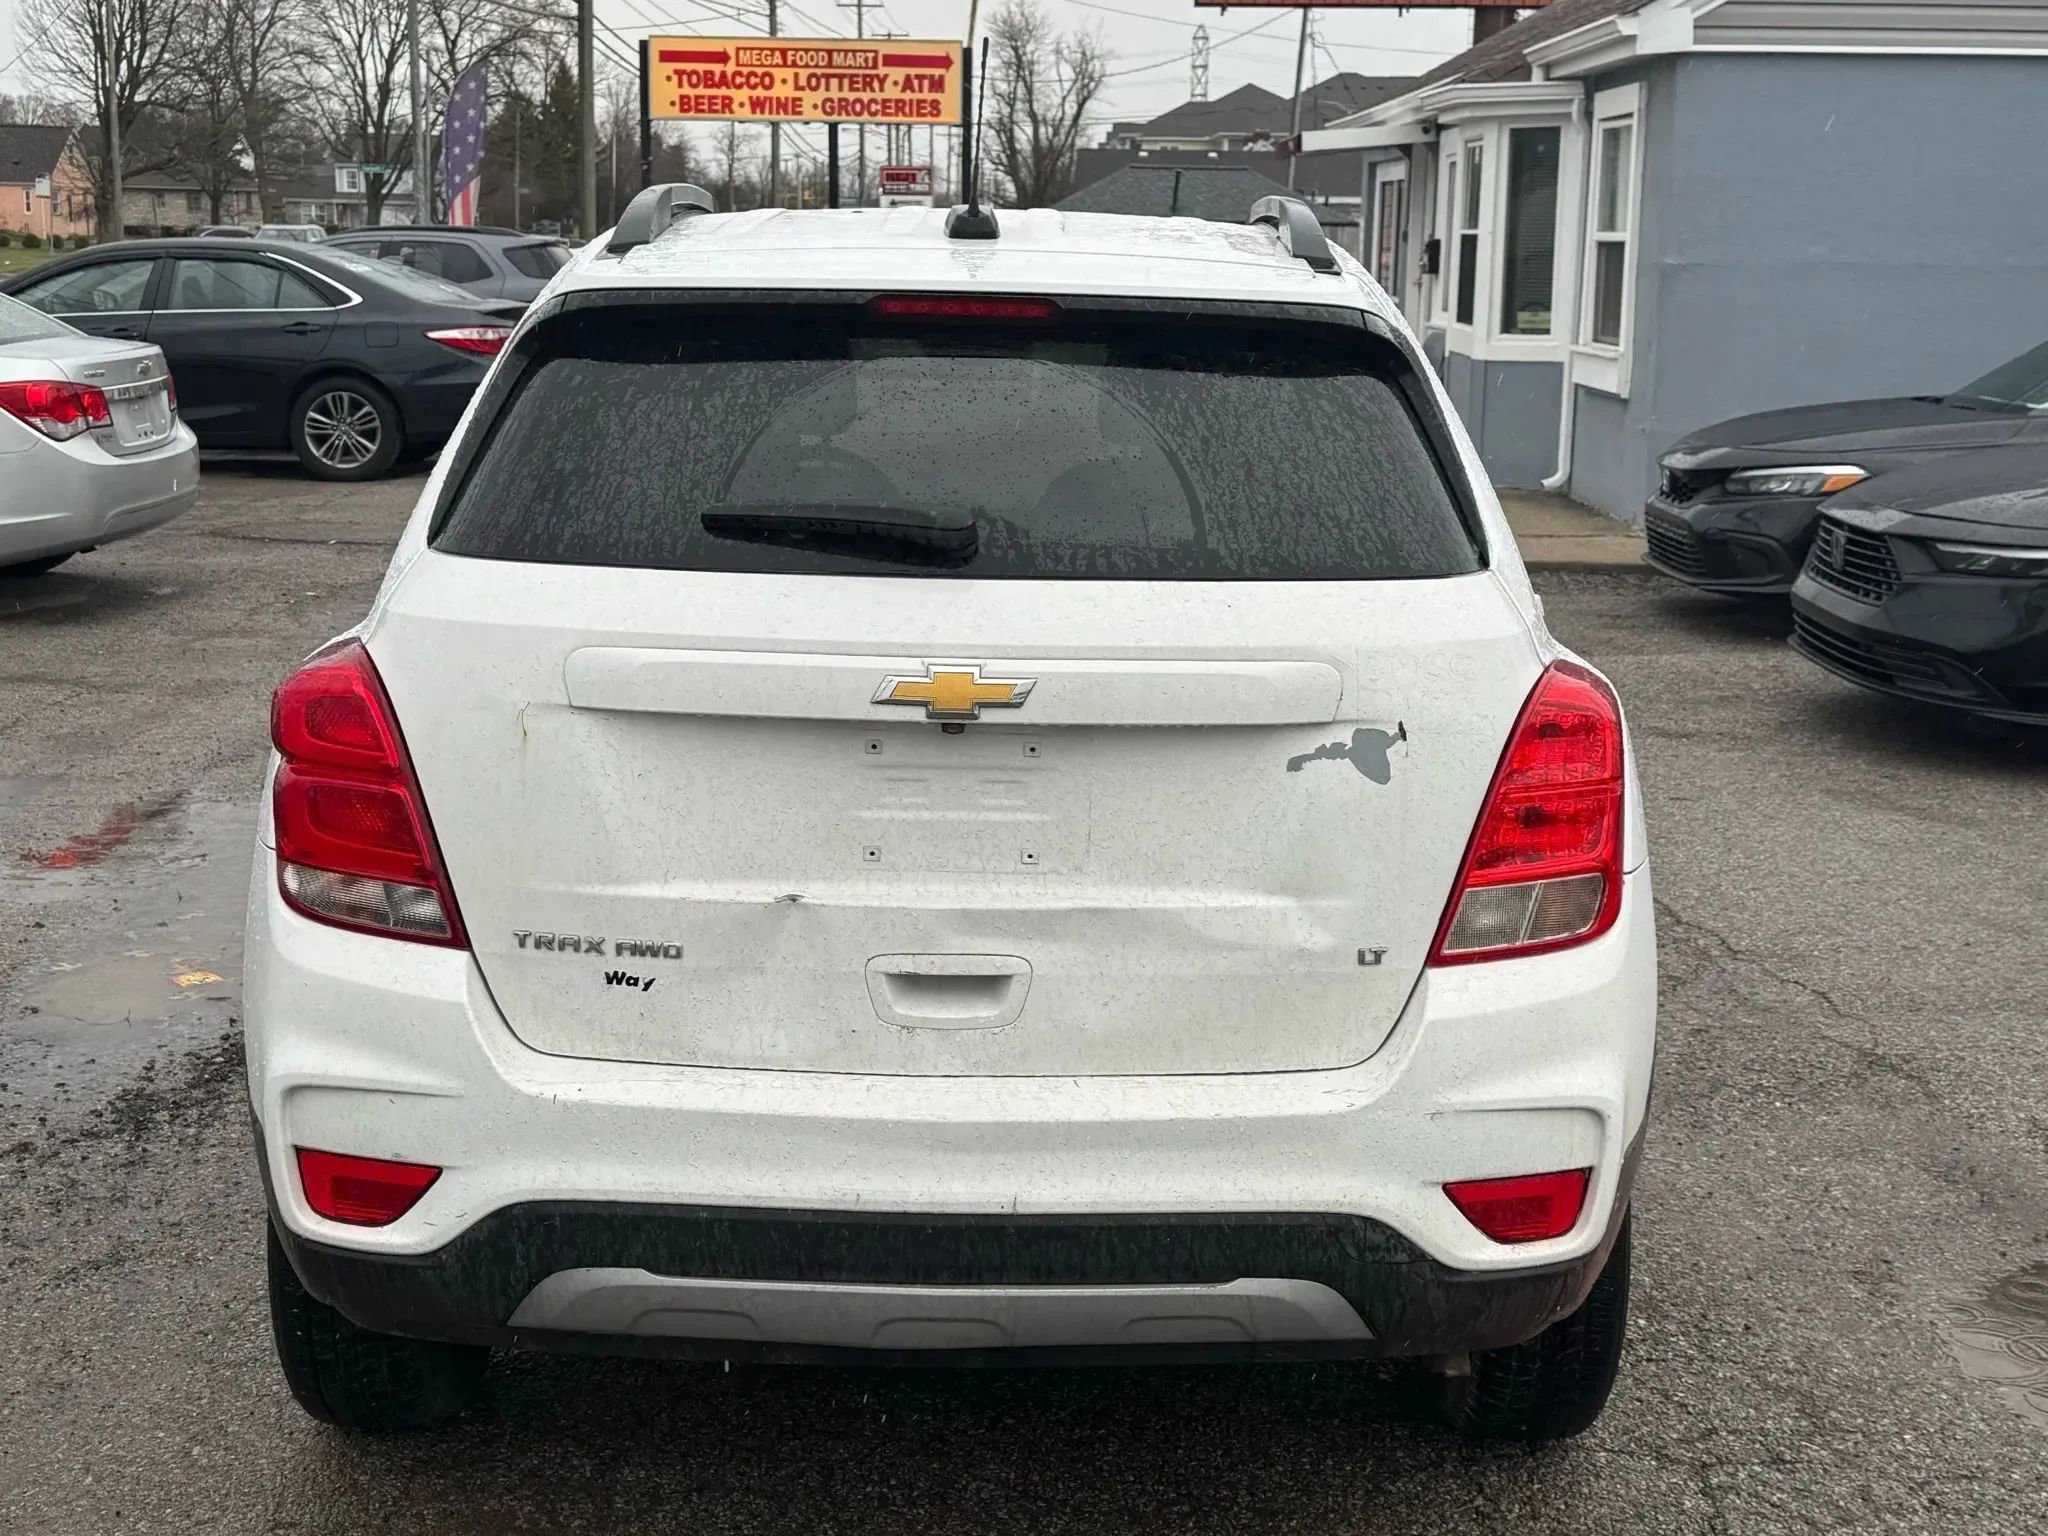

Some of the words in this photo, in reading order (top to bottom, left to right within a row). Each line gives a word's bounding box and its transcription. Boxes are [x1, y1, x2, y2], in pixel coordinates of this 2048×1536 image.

[738, 50, 783, 66] MEGA
[786, 50, 828, 67] FOOD
[832, 51, 876, 68] MART
[673, 69, 775, 91] TOBACCO
[793, 72, 889, 93] LOTTERY
[900, 74, 945, 94] ATM
[678, 94, 735, 114] BEER
[748, 96, 804, 116] WINE
[821, 97, 942, 118] GROCERIES
[513, 929, 606, 956] TRAX
[615, 938, 683, 960] AWD
[1357, 946, 1388, 966] LT
[604, 970, 656, 991] Way
